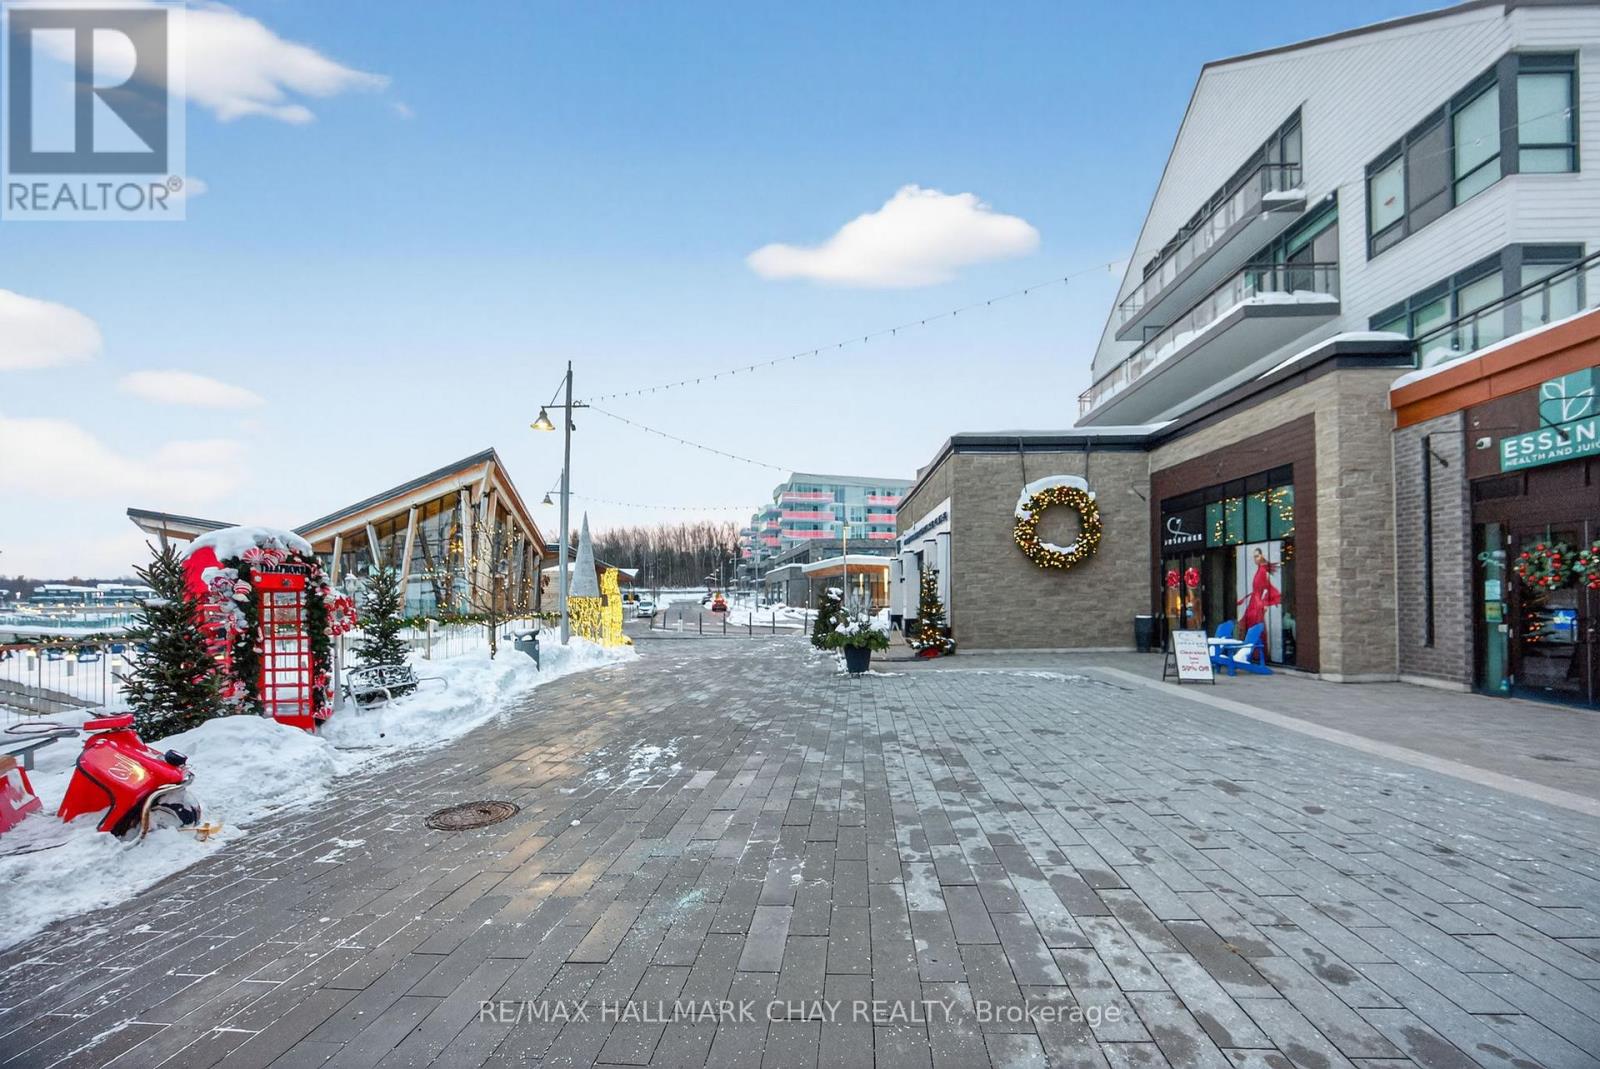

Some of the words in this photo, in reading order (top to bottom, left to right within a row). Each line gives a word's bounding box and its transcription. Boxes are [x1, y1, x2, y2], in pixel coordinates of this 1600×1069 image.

[1504, 421, 1596, 458] ESSEN
[1504, 452, 1546, 466] HEALTH
[1548, 447, 1573, 458] AND
